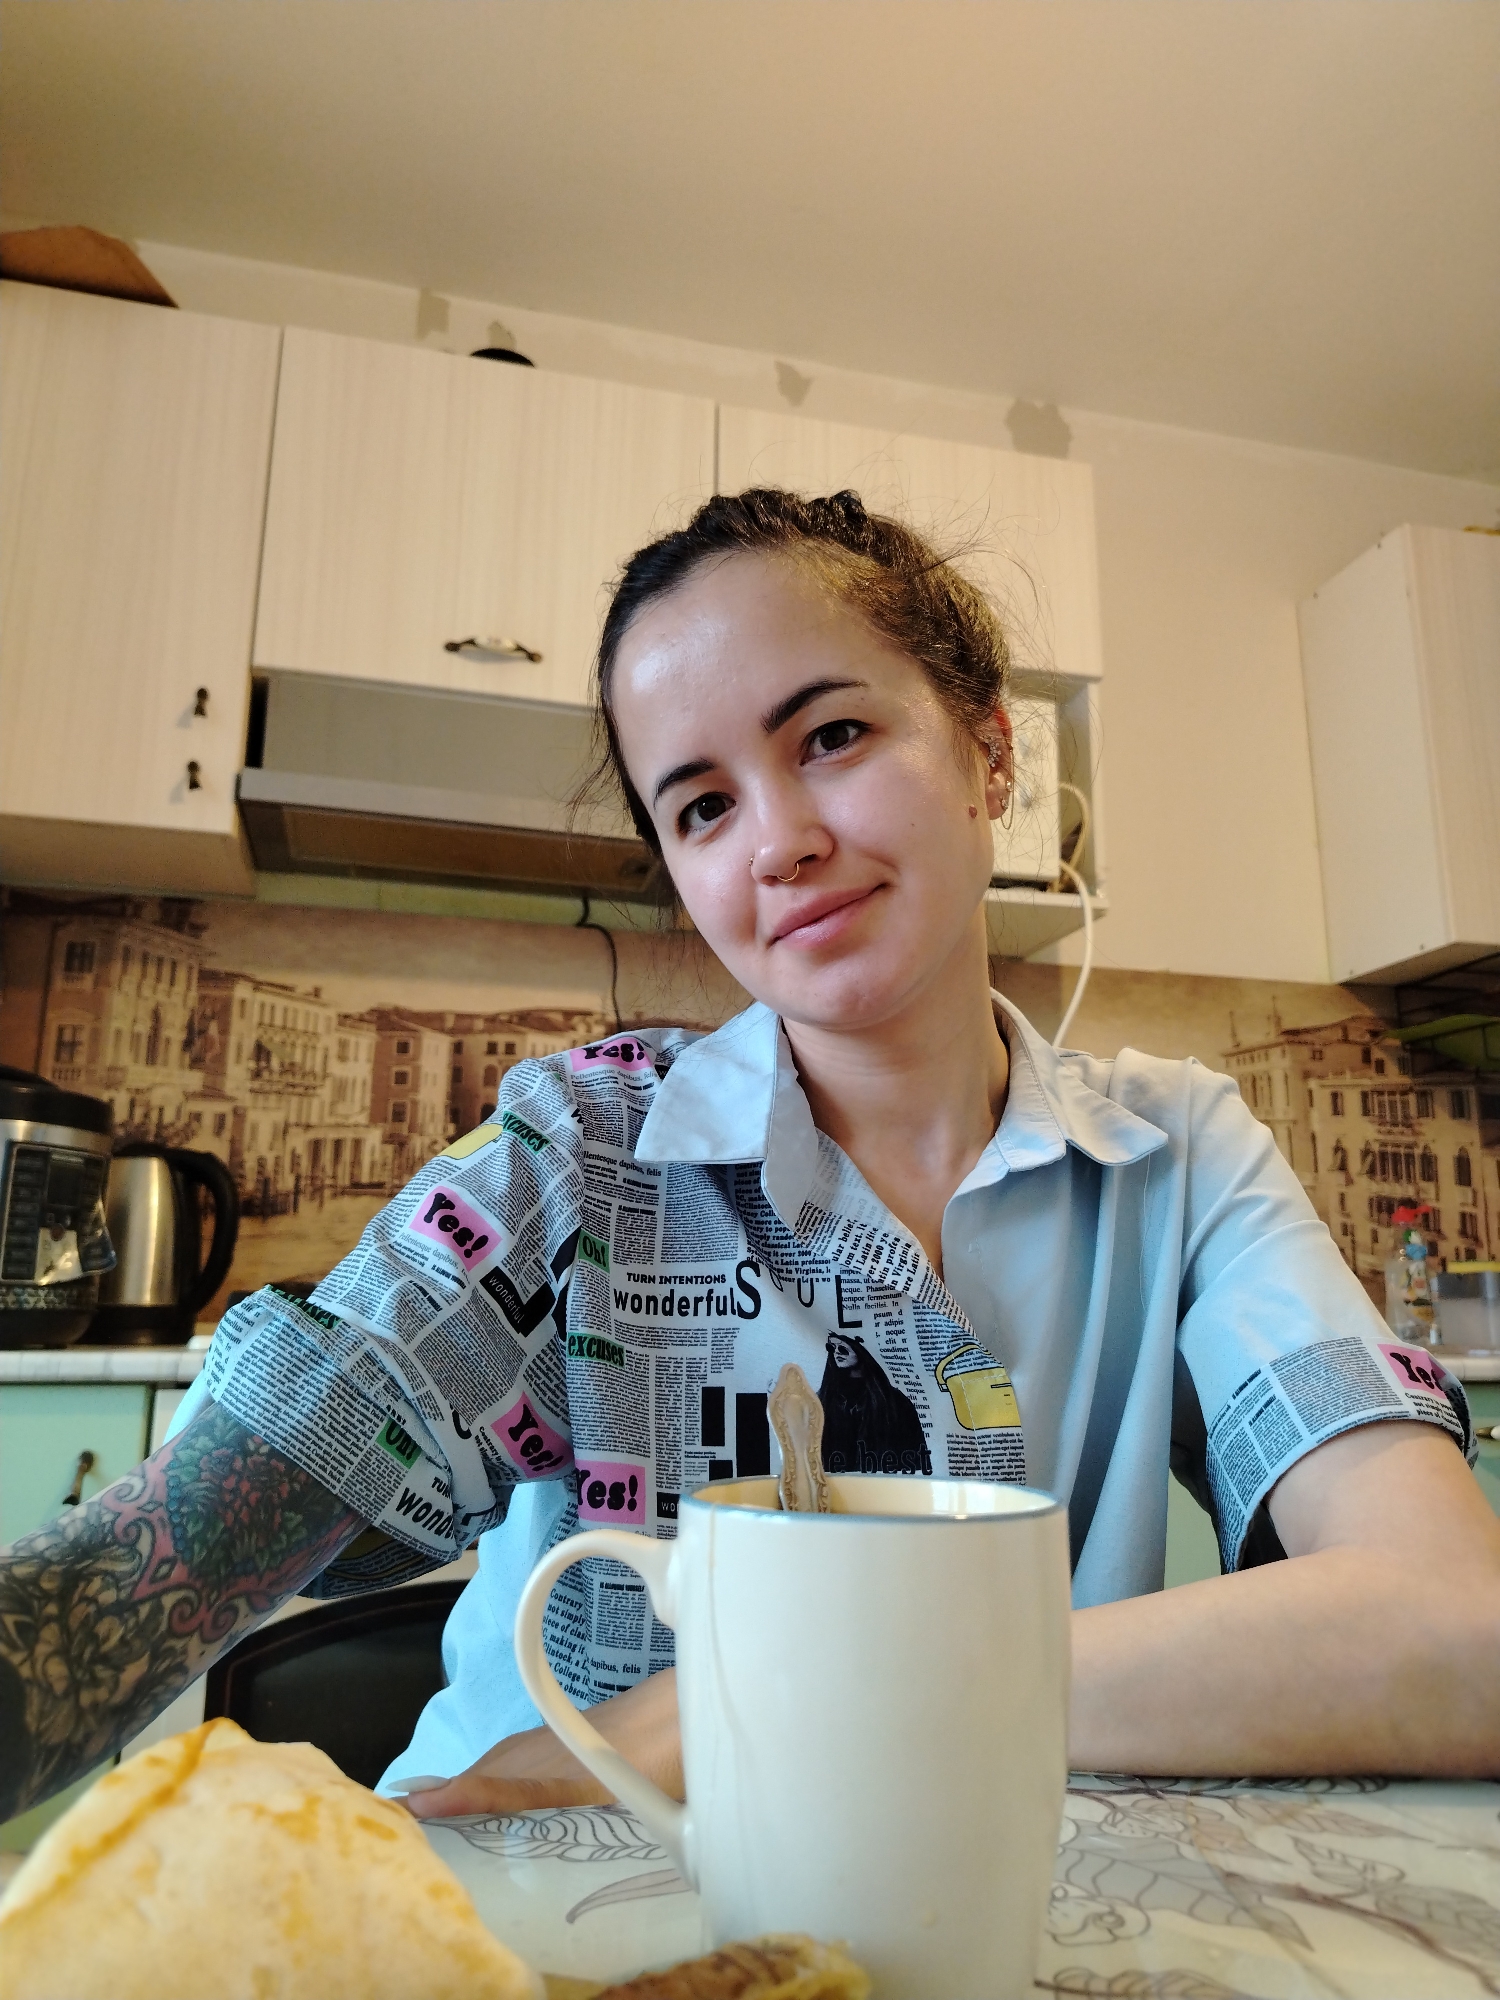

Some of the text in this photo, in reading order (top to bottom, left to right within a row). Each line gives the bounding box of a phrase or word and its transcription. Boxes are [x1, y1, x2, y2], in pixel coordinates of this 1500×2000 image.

[646, 1168, 661, 1177] felis
[424, 1193, 489, 1258] Yes!
[582, 1235, 607, 1267] Oh!
[626, 1272, 727, 1285] TURN INTENTIONS
[488, 1275, 525, 1324] wonderful
[613, 1287, 737, 1317] wonderful
[567, 1335, 625, 1368] excuses
[508, 1403, 564, 1471] Yes!
[550, 1588, 584, 1610] Contrary
[560, 1608, 587, 1627] simply
[561, 1621, 570, 1633] of
[549, 1632, 578, 1651] making
[579, 1644, 585, 1656] it
[554, 1662, 581, 1682] College
[622, 1663, 642, 1674] felis
